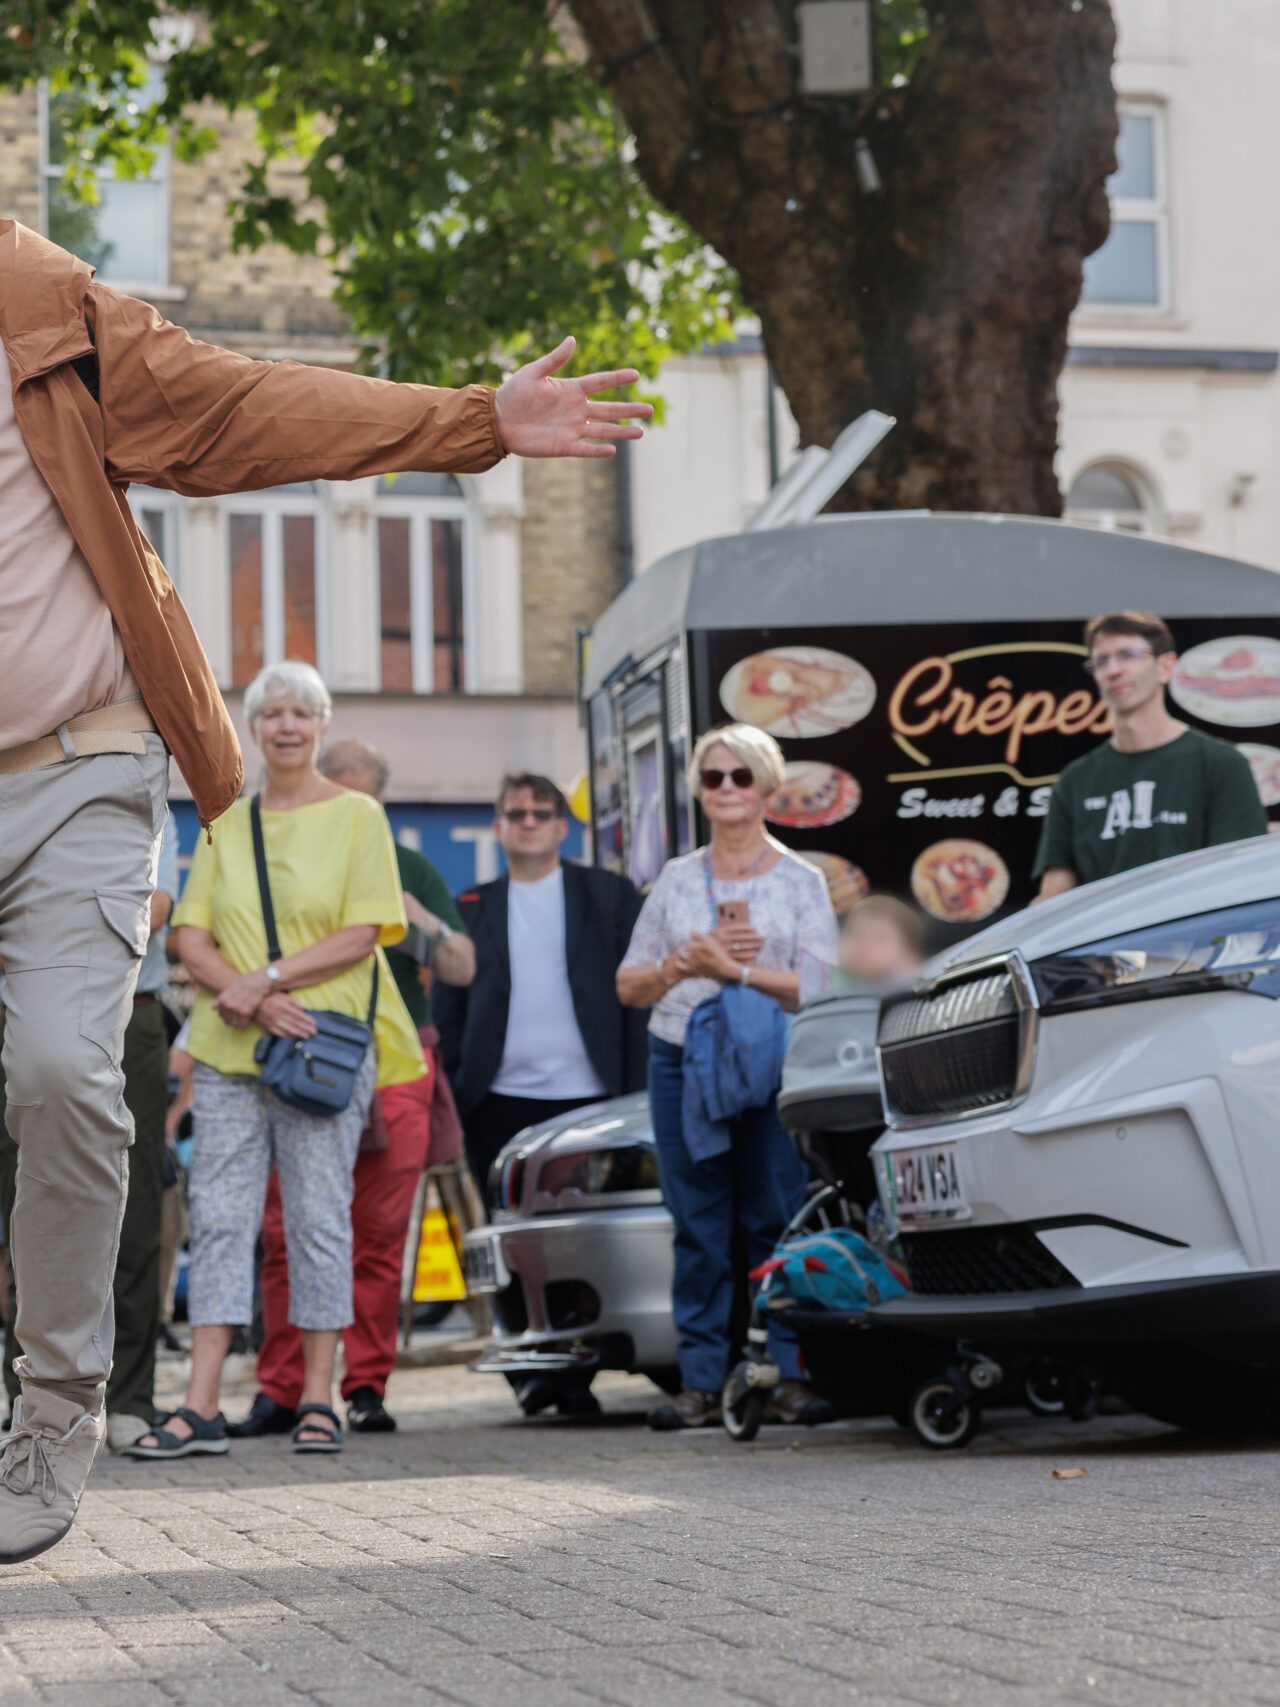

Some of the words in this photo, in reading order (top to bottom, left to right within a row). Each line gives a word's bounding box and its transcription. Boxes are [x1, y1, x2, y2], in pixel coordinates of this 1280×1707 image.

[888, 655, 1113, 764] Crêpes
[896, 787, 985, 819] Sweet
[993, 786, 1019, 817] &
[1026, 786, 1053, 817] S
[927, 1152, 961, 1200] VSA
